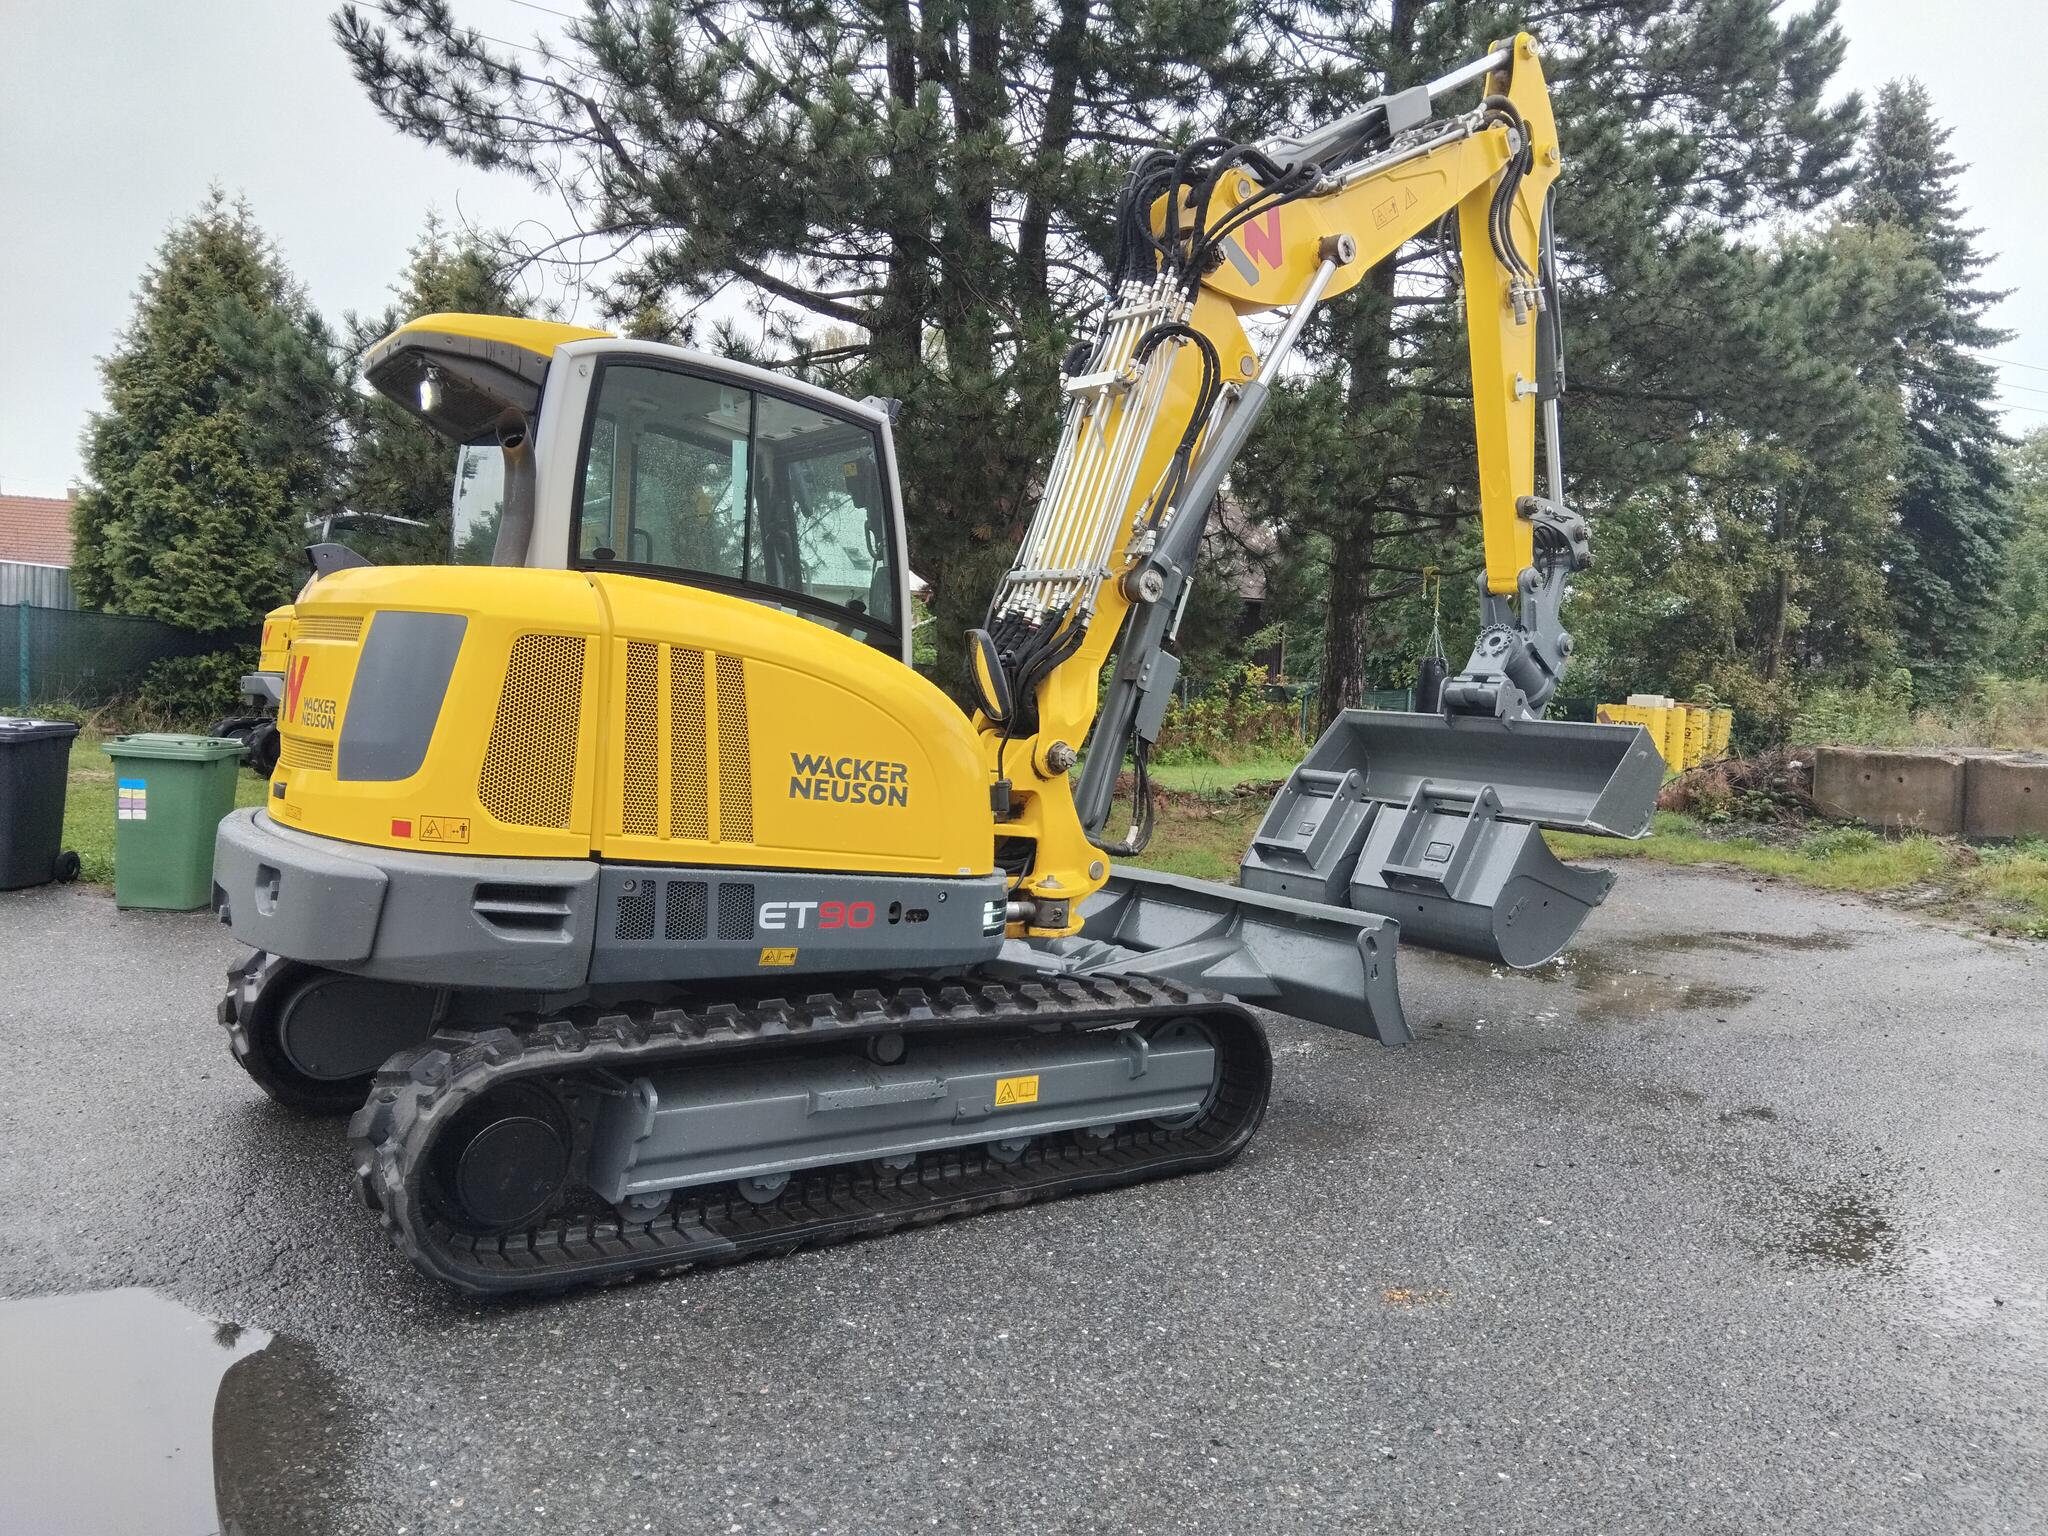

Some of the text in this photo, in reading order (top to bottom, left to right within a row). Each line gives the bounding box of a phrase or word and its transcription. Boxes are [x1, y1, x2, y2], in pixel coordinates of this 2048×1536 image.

[303, 697, 337, 714] WACKER
[302, 712, 336, 730] NEUSON
[790, 752, 909, 785] WACKER
[789, 776, 908, 807] NEUSON
[759, 901, 875, 929] ET90
